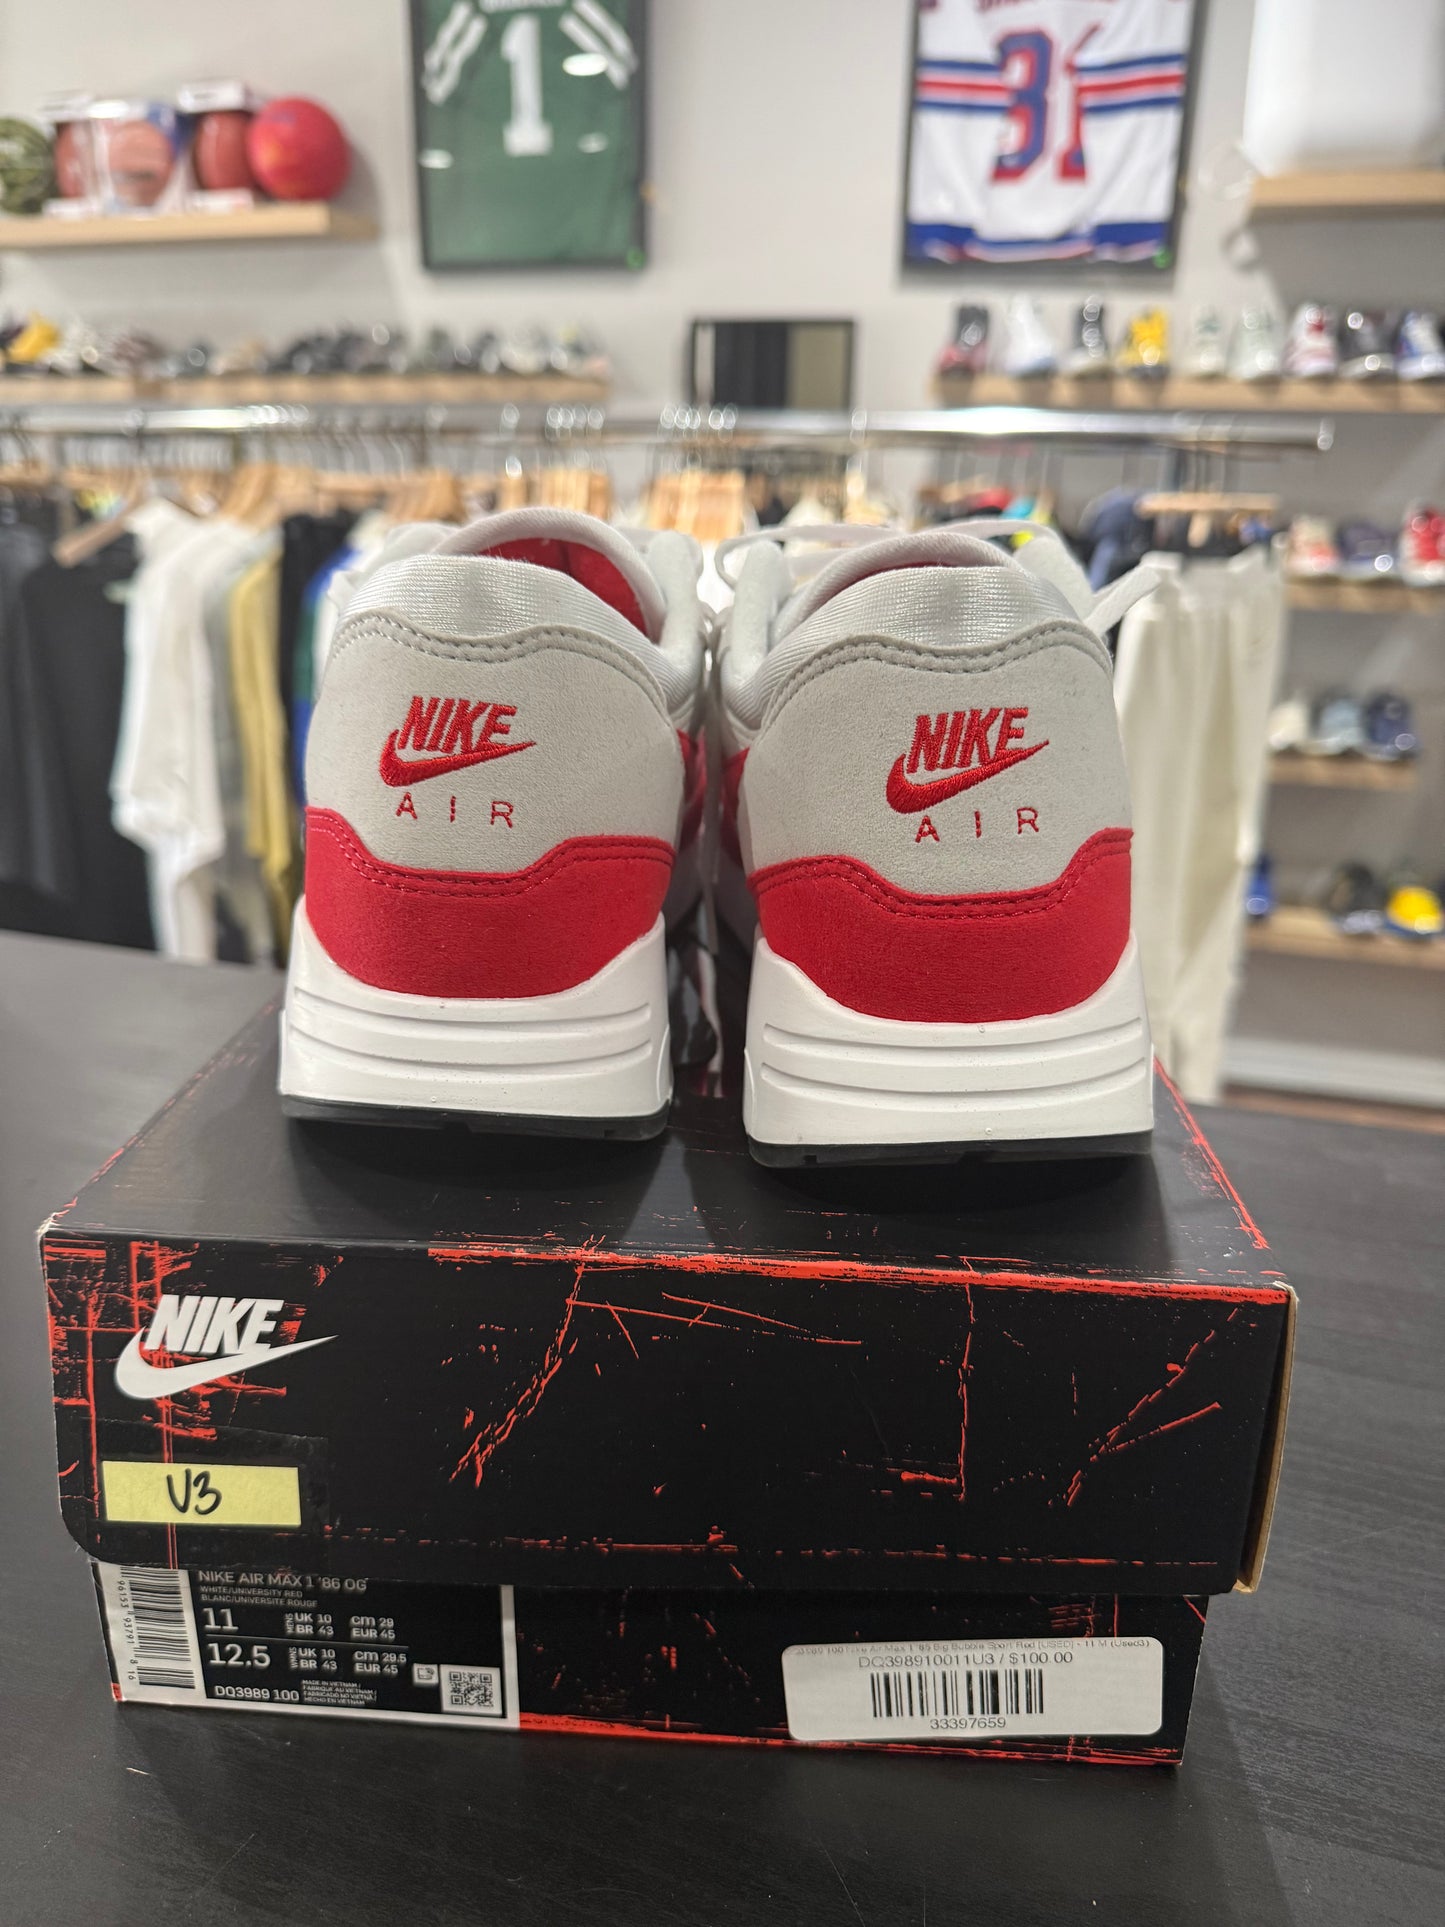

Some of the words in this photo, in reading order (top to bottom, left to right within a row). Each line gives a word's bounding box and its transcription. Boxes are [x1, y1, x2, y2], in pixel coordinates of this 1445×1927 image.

[500, 14, 553, 157] 1
[397, 695, 518, 754] NIKE
[906, 706, 1029, 774] NIKE
[395, 791, 514, 829] AIR
[914, 806, 1040, 844] AIR
[143, 1294, 284, 1355] NIKE
[199, 1570, 235, 1583] NIKE
[239, 1572, 264, 1585] AIR
[268, 1573, 303, 1587] MAX
[305, 1575, 315, 1588] 1
[344, 1578, 368, 1591] OG
[203, 1607, 239, 1630] 11
[295, 1612, 314, 1623] UK
[317, 1613, 333, 1624] 10
[379, 1617, 395, 1628] 29
[297, 1624, 314, 1635] BR
[319, 1625, 334, 1636] 43
[352, 1628, 378, 1639] EUR
[380, 1629, 396, 1640] 45
[208, 1643, 271, 1668] 12.5
[298, 1647, 318, 1658] UK
[321, 1649, 336, 1659] 10
[382, 1652, 407, 1664] 29.5
[1009, 1651, 1073, 1665] $100.00
[300, 1659, 318, 1669] BR
[322, 1660, 338, 1671] 43
[355, 1662, 381, 1674] EUR
[383, 1664, 399, 1675] 45
[215, 1685, 271, 1700] DQ3989
[272, 1689, 300, 1701] 100
[930, 1716, 1007, 1730] 33397659
